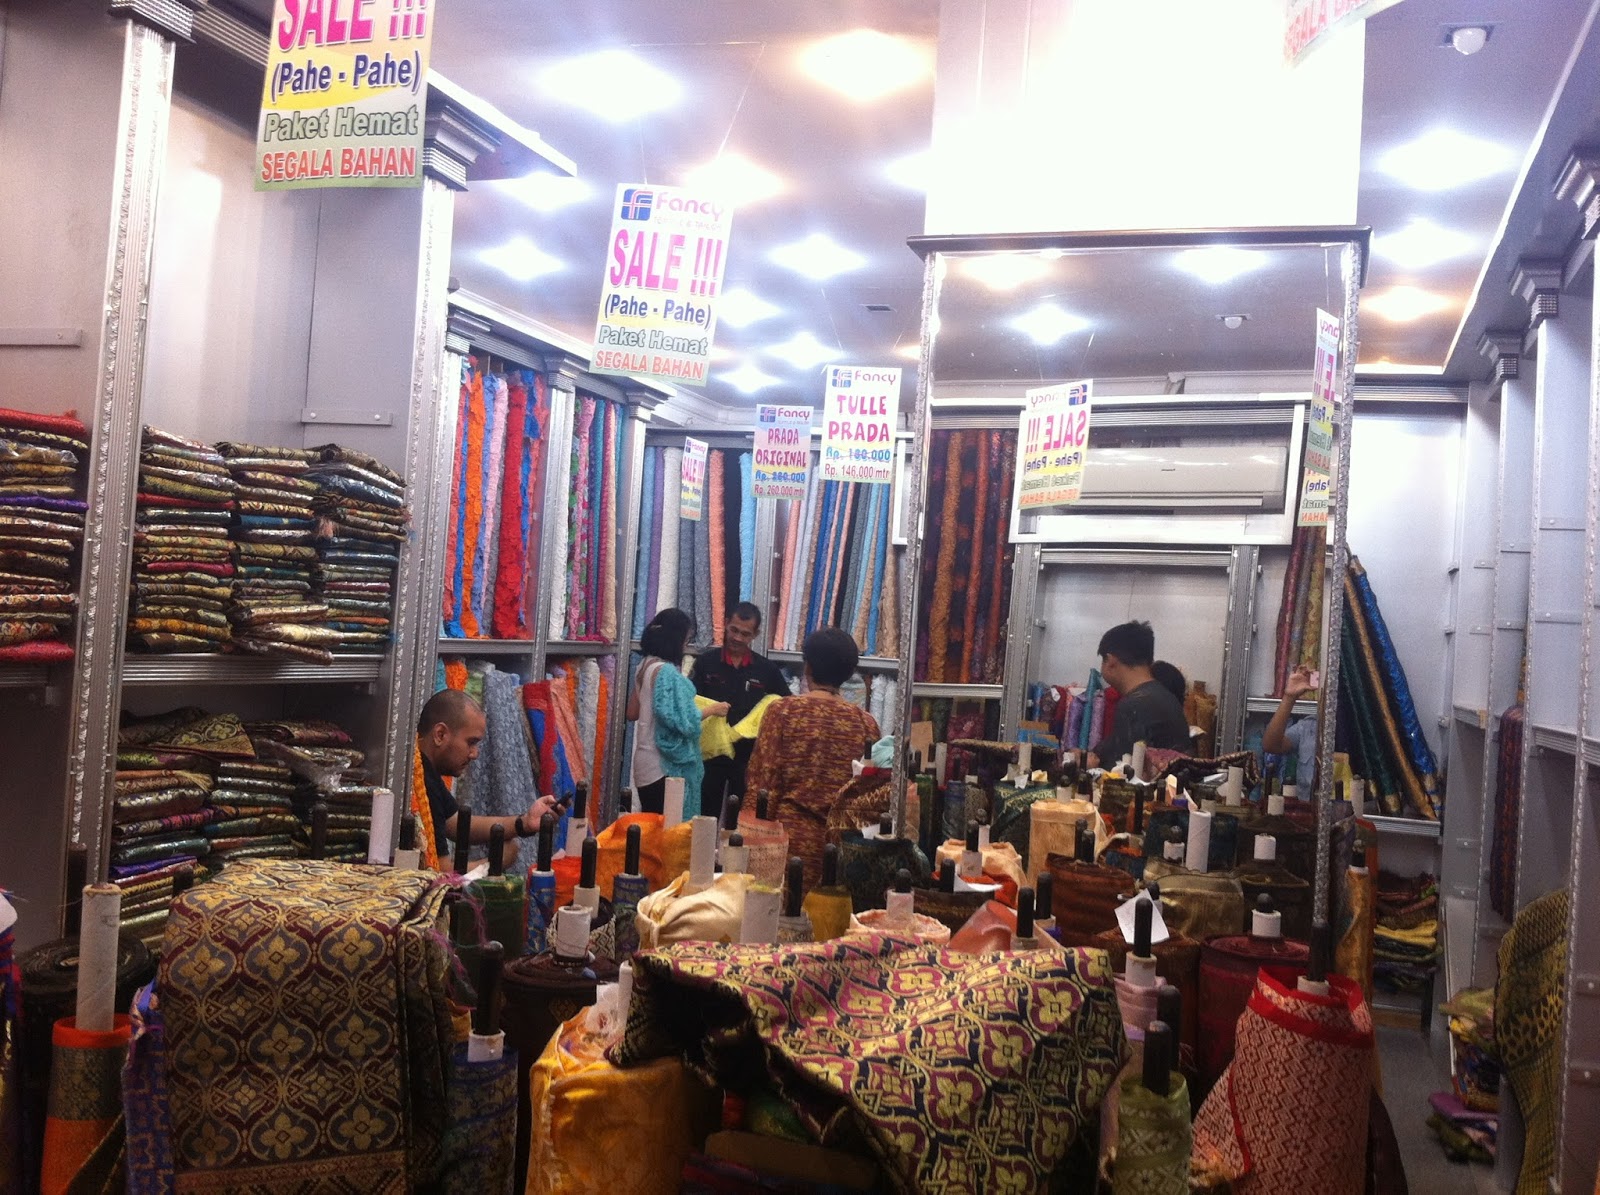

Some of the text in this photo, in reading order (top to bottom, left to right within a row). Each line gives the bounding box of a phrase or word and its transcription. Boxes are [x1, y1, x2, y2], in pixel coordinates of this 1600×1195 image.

[278, 0, 375, 50] SALE
[271, 60, 331, 103] (Pahe
[353, 51, 422, 94] Pahe)
[263, 104, 419, 142] Paket Hemat
[262, 147, 415, 181] SEGALA BAHAN
[655, 191, 724, 221] Fancy
[609, 229, 723, 296] SALE !!!
[604, 293, 648, 318] (Pahe
[663, 299, 711, 330] Pahe)
[599, 325, 708, 356] Paket Hemat
[595, 350, 704, 379] SEGALA BAHAN
[855, 370, 896, 385] Fancy
[778, 407, 810, 420] Fancy
[837, 394, 887, 415] TULLE
[768, 428, 799, 444] PRADA
[828, 421, 890, 442] PRADA
[755, 448, 806, 467] ORIGINAL
